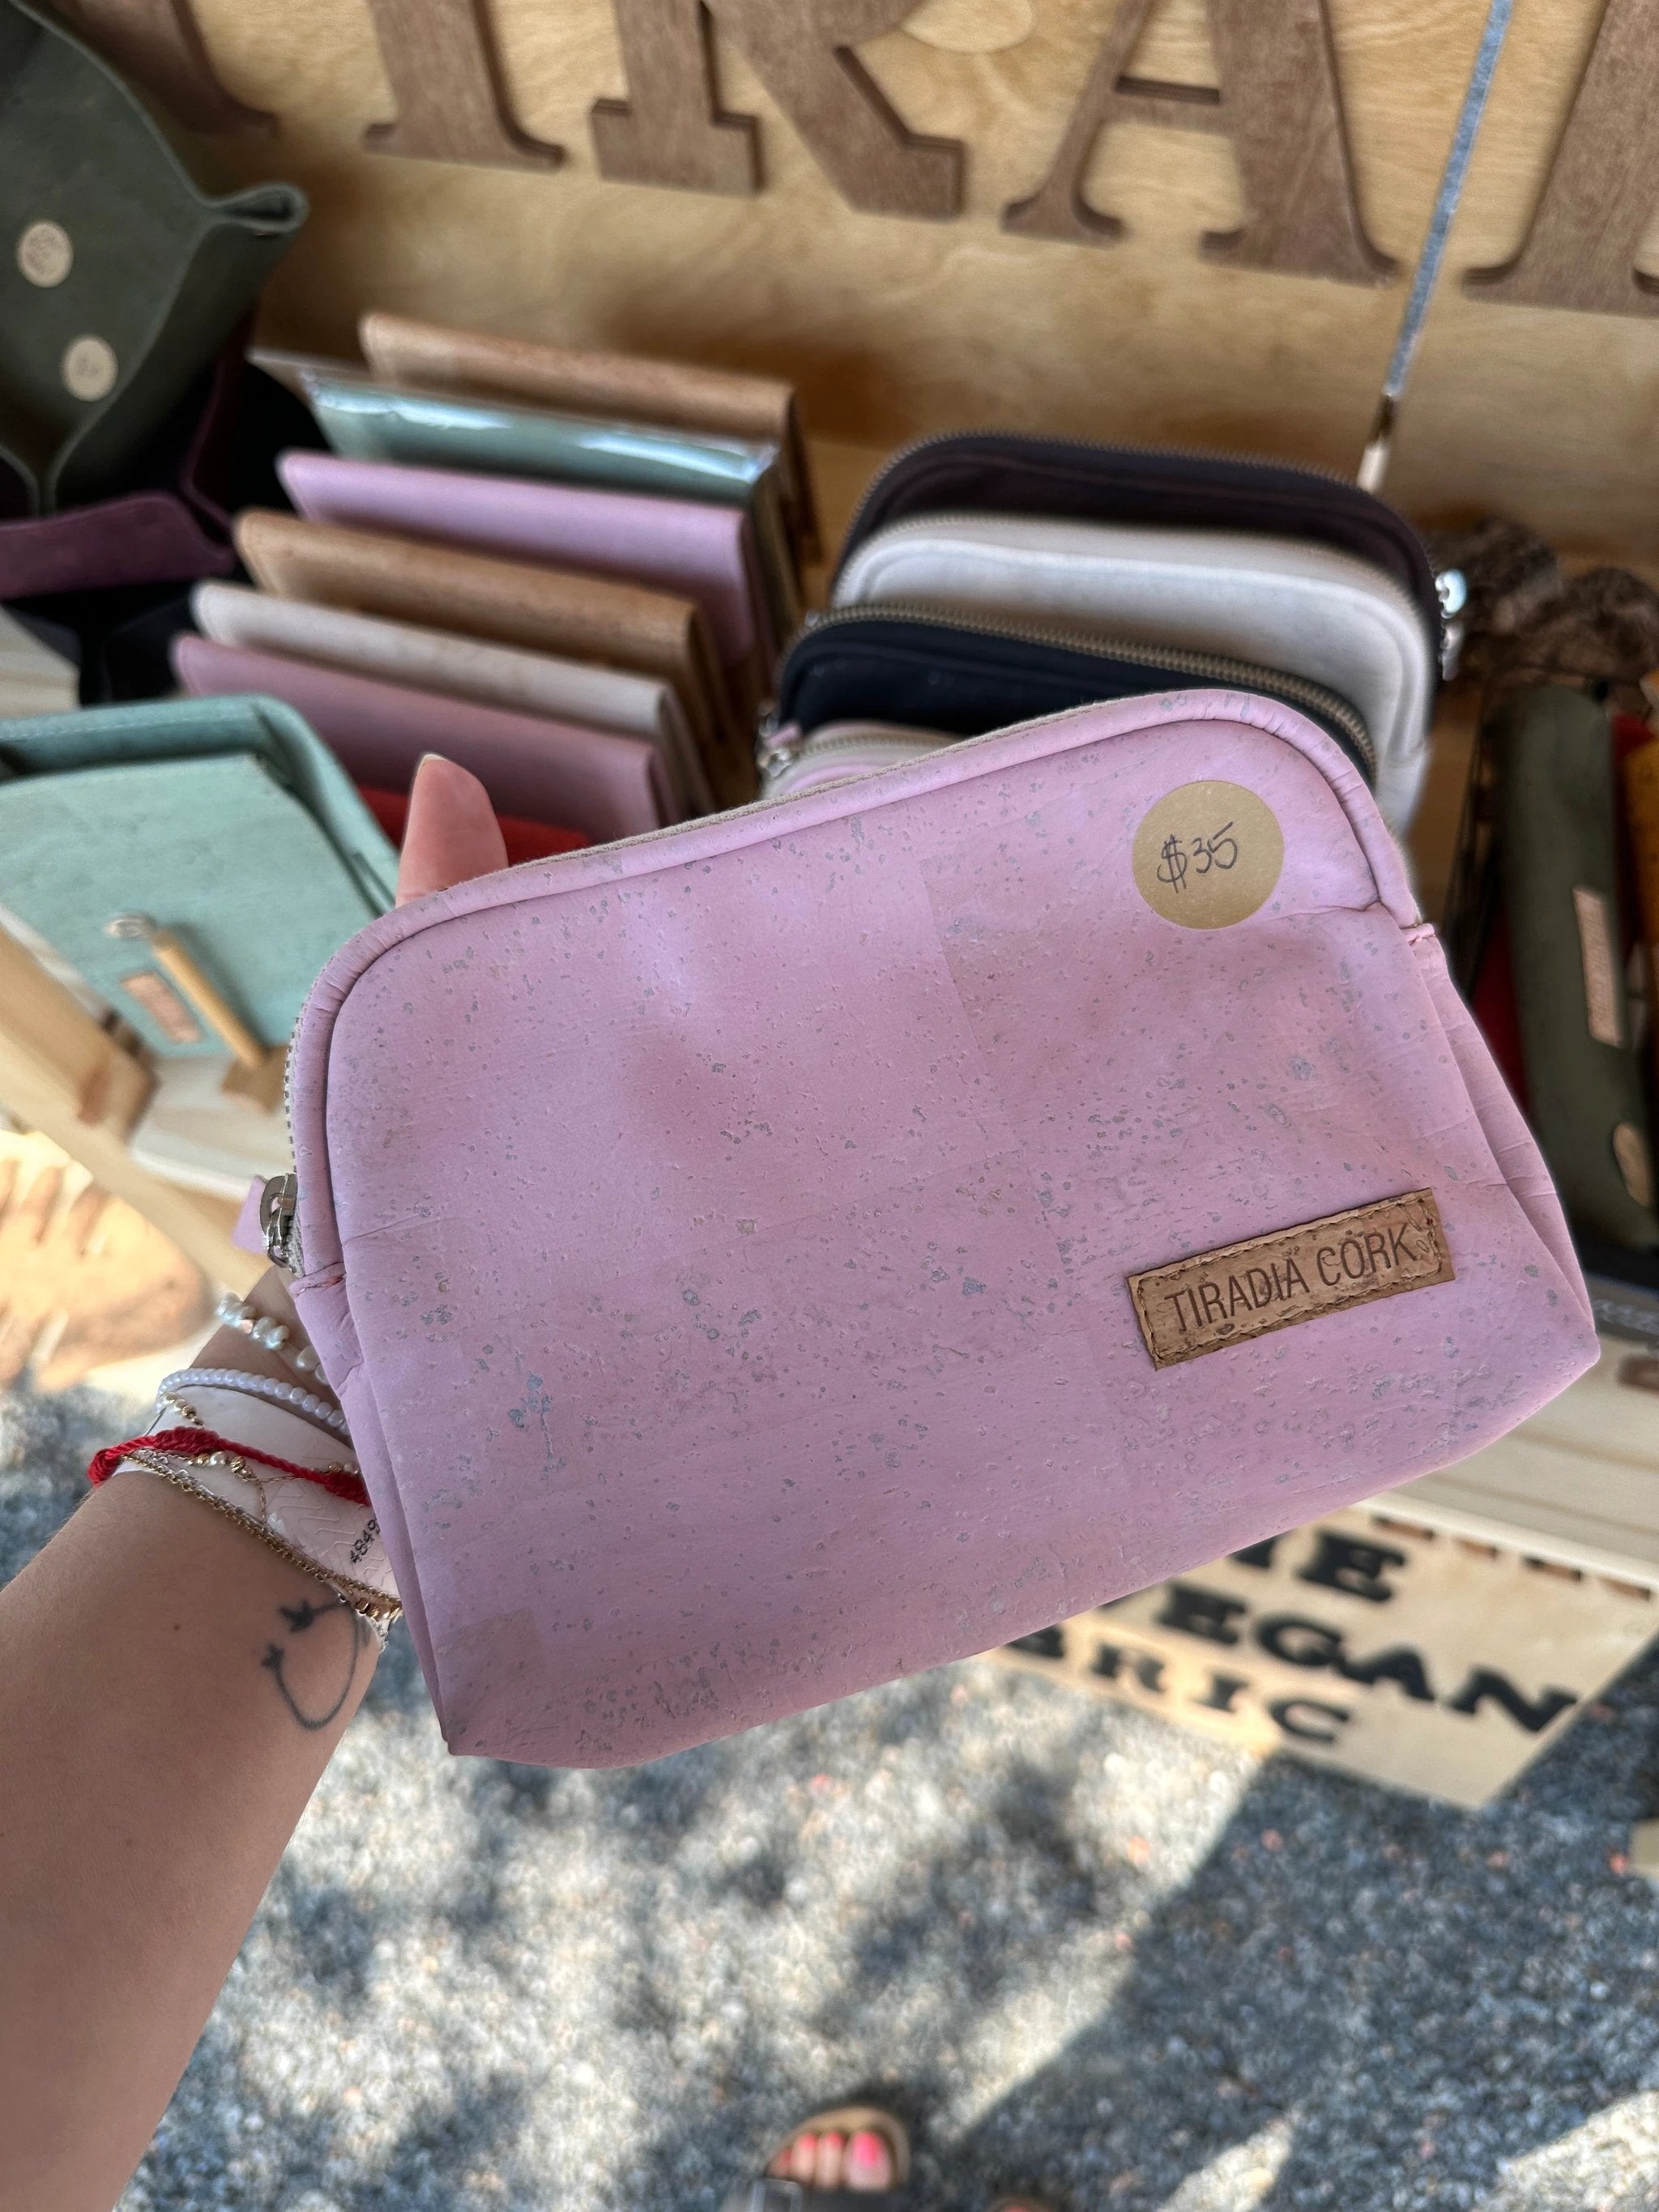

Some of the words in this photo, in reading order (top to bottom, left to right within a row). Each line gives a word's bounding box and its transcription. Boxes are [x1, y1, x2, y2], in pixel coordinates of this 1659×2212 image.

[1157, 821, 1238, 893] $35
[1164, 1258, 1311, 1332] TIRADIA
[1316, 1221, 1418, 1286] CORK
[1097, 1582, 1580, 1733] EGAN
